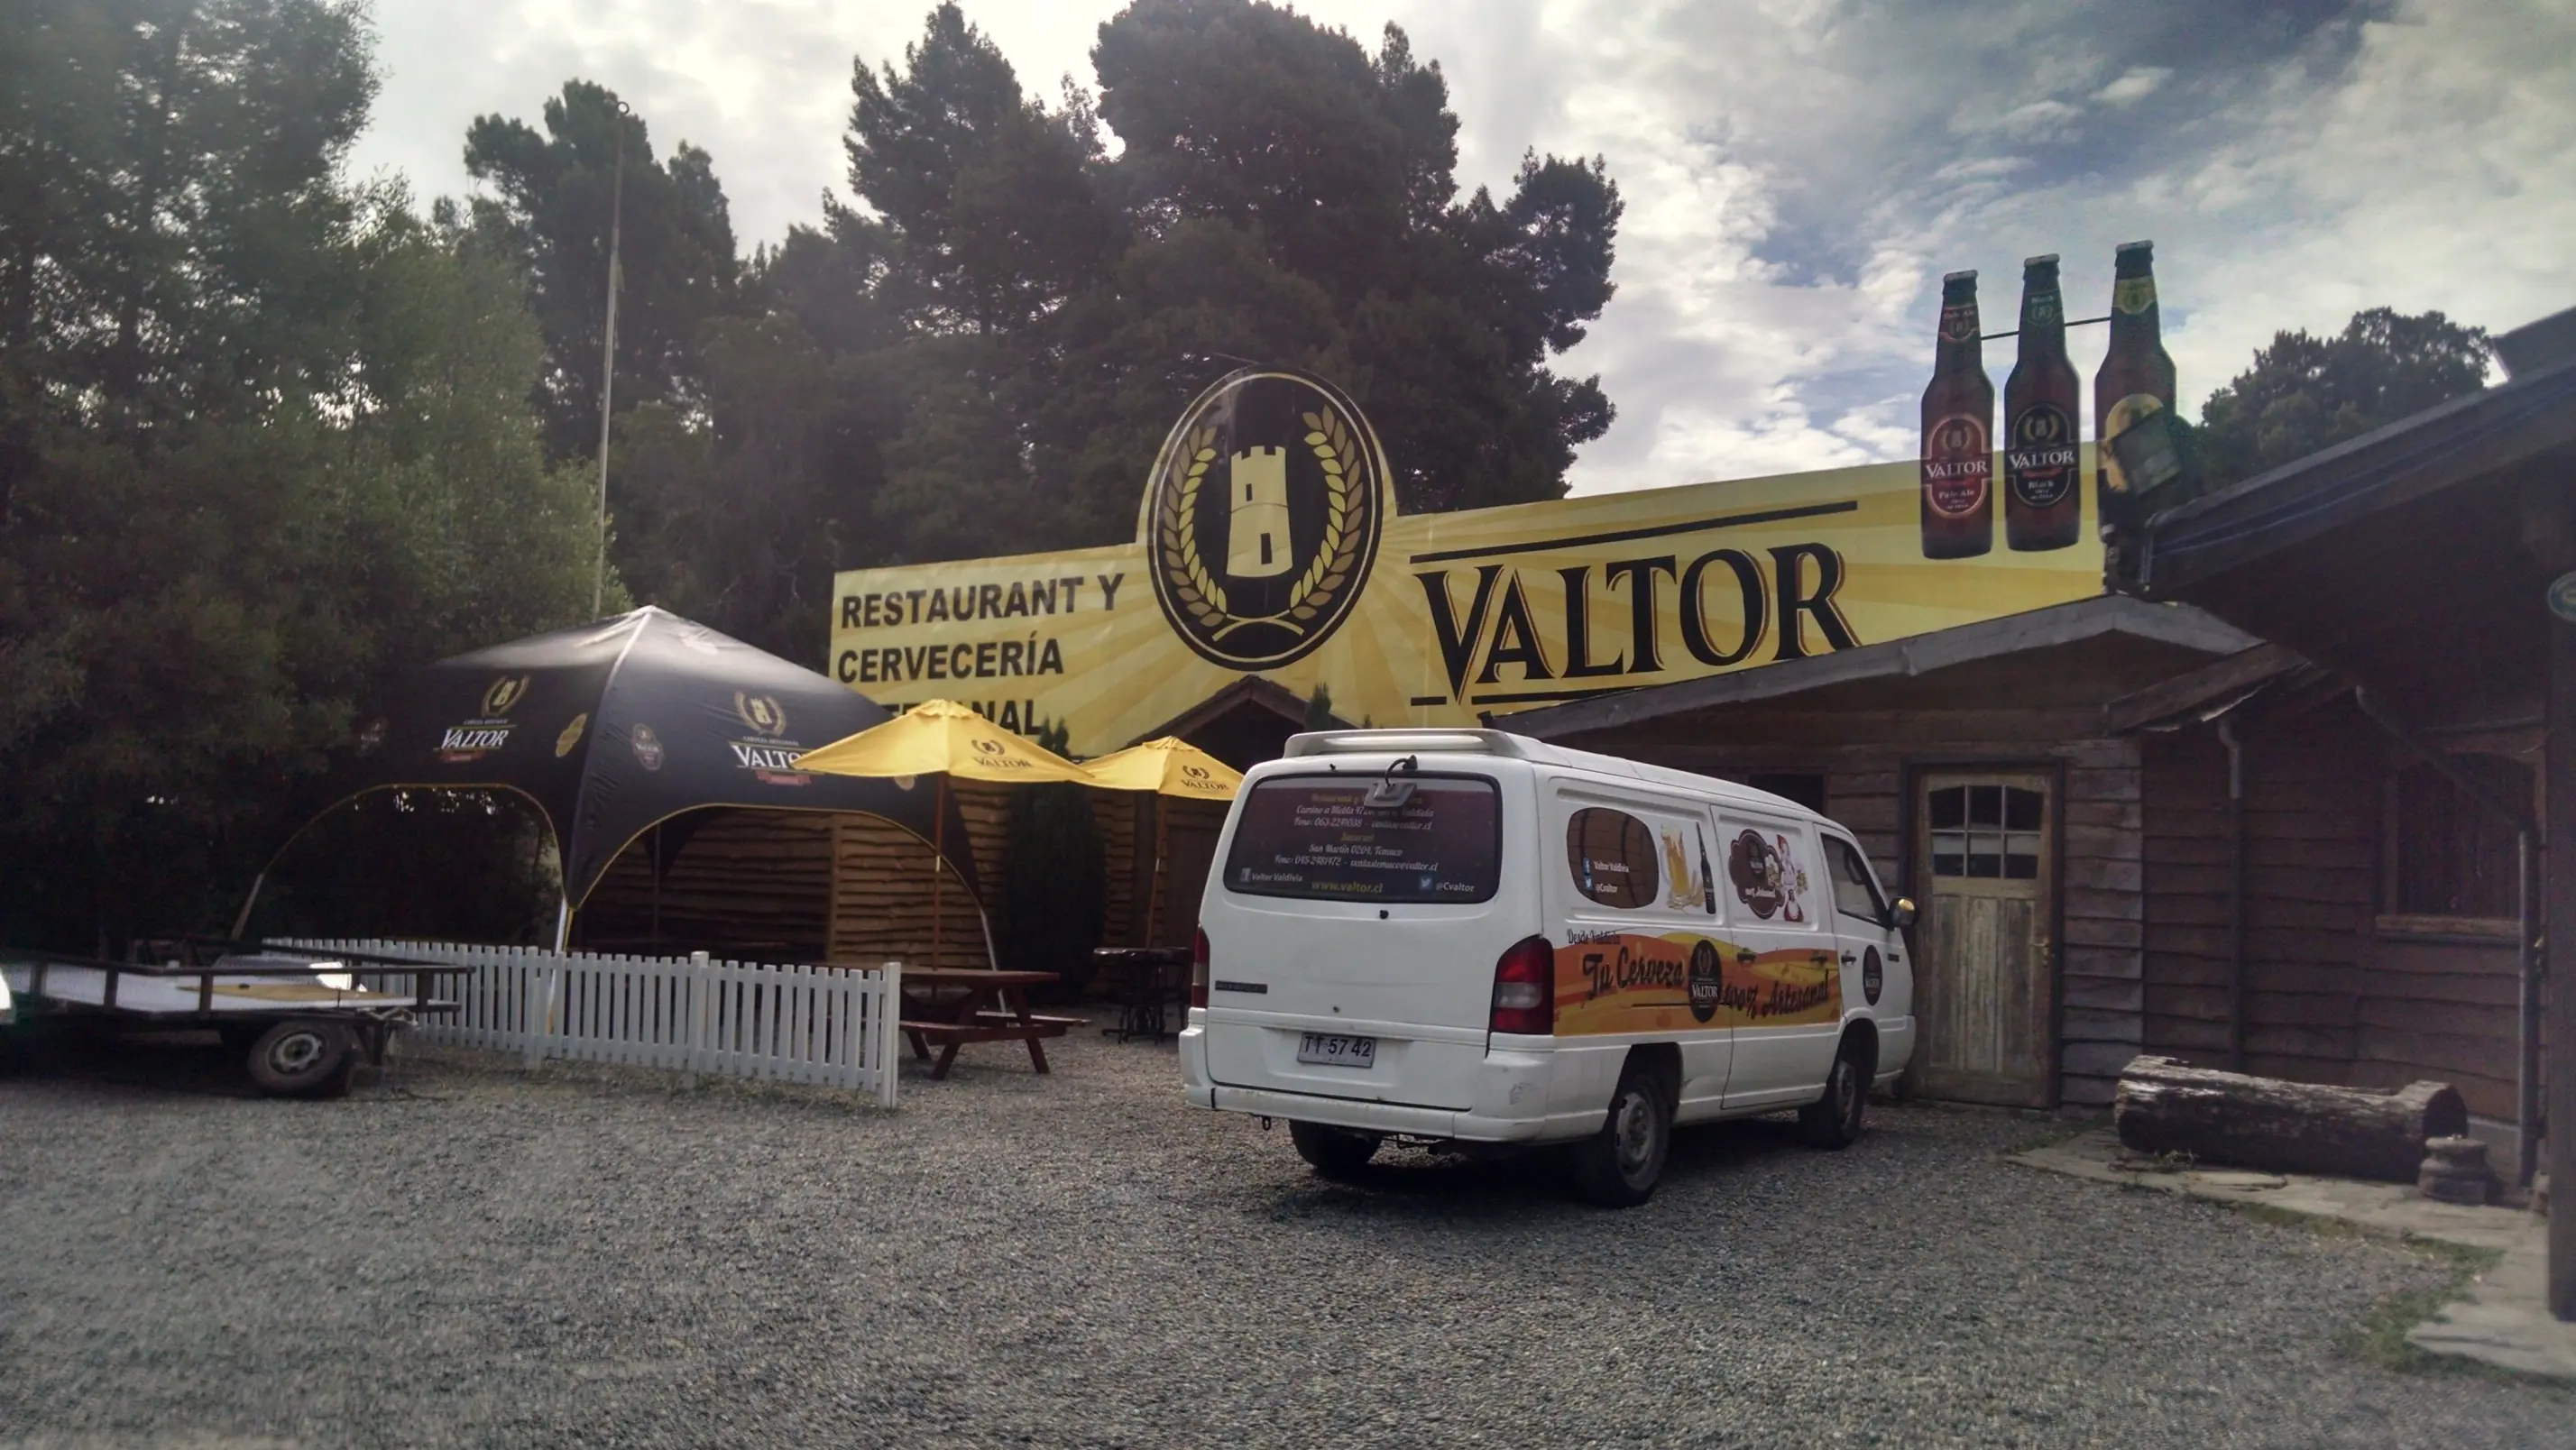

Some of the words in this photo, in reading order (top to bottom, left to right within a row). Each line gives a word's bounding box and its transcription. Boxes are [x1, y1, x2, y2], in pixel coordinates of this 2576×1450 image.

[2010, 451, 2075, 469] VALTOR
[1925, 460, 1988, 479] VALTOR
[841, 575, 1085, 629] RESTAURANT
[1097, 573, 1126, 611] Y
[1412, 542, 1862, 705] VALTOR
[837, 629, 1064, 684] CERVECERÍA
[441, 729, 510, 750] VALTOR
[731, 745, 805, 769] VALTO
[971, 756, 1034, 768] VALTOR
[1180, 778, 1230, 791] VALTOR
[1308, 843, 1324, 853] San
[1252, 872, 1273, 882] Valtor
[1274, 872, 1303, 883] Valdivia
[1311, 881, 1384, 895] www.valtor.cl
[1435, 882, 1476, 893] @Cvaltor
[1582, 953, 1614, 1001] Tu
[1616, 945, 1686, 989] Cerveza
[1691, 984, 1718, 998] VALTOR
